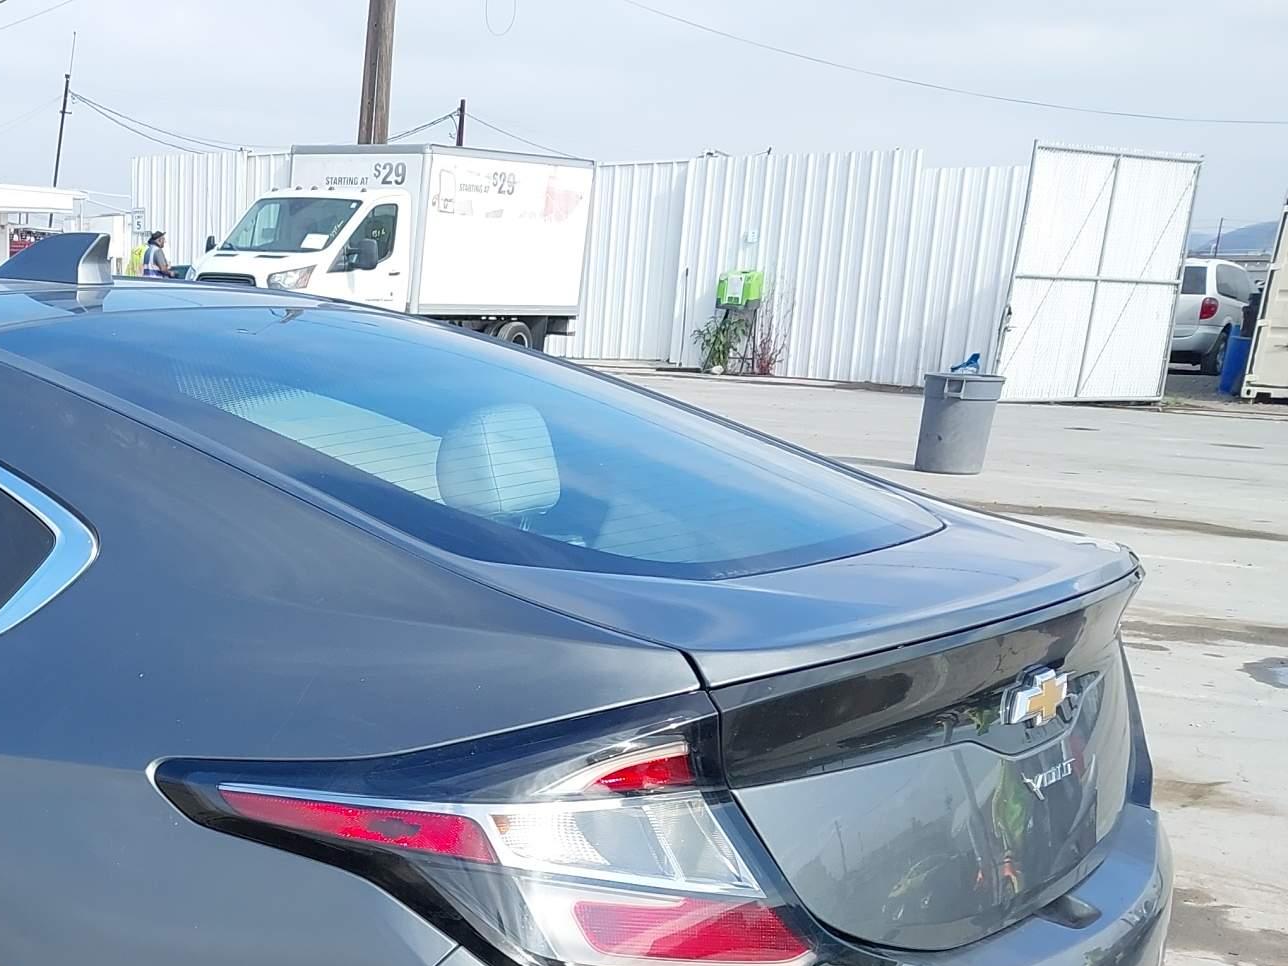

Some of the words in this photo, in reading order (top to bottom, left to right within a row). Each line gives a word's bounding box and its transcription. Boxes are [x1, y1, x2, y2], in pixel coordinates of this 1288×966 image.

[325, 176, 358, 185] STARTING
[360, 176, 368, 185] AT
[373, 162, 406, 185] $29
